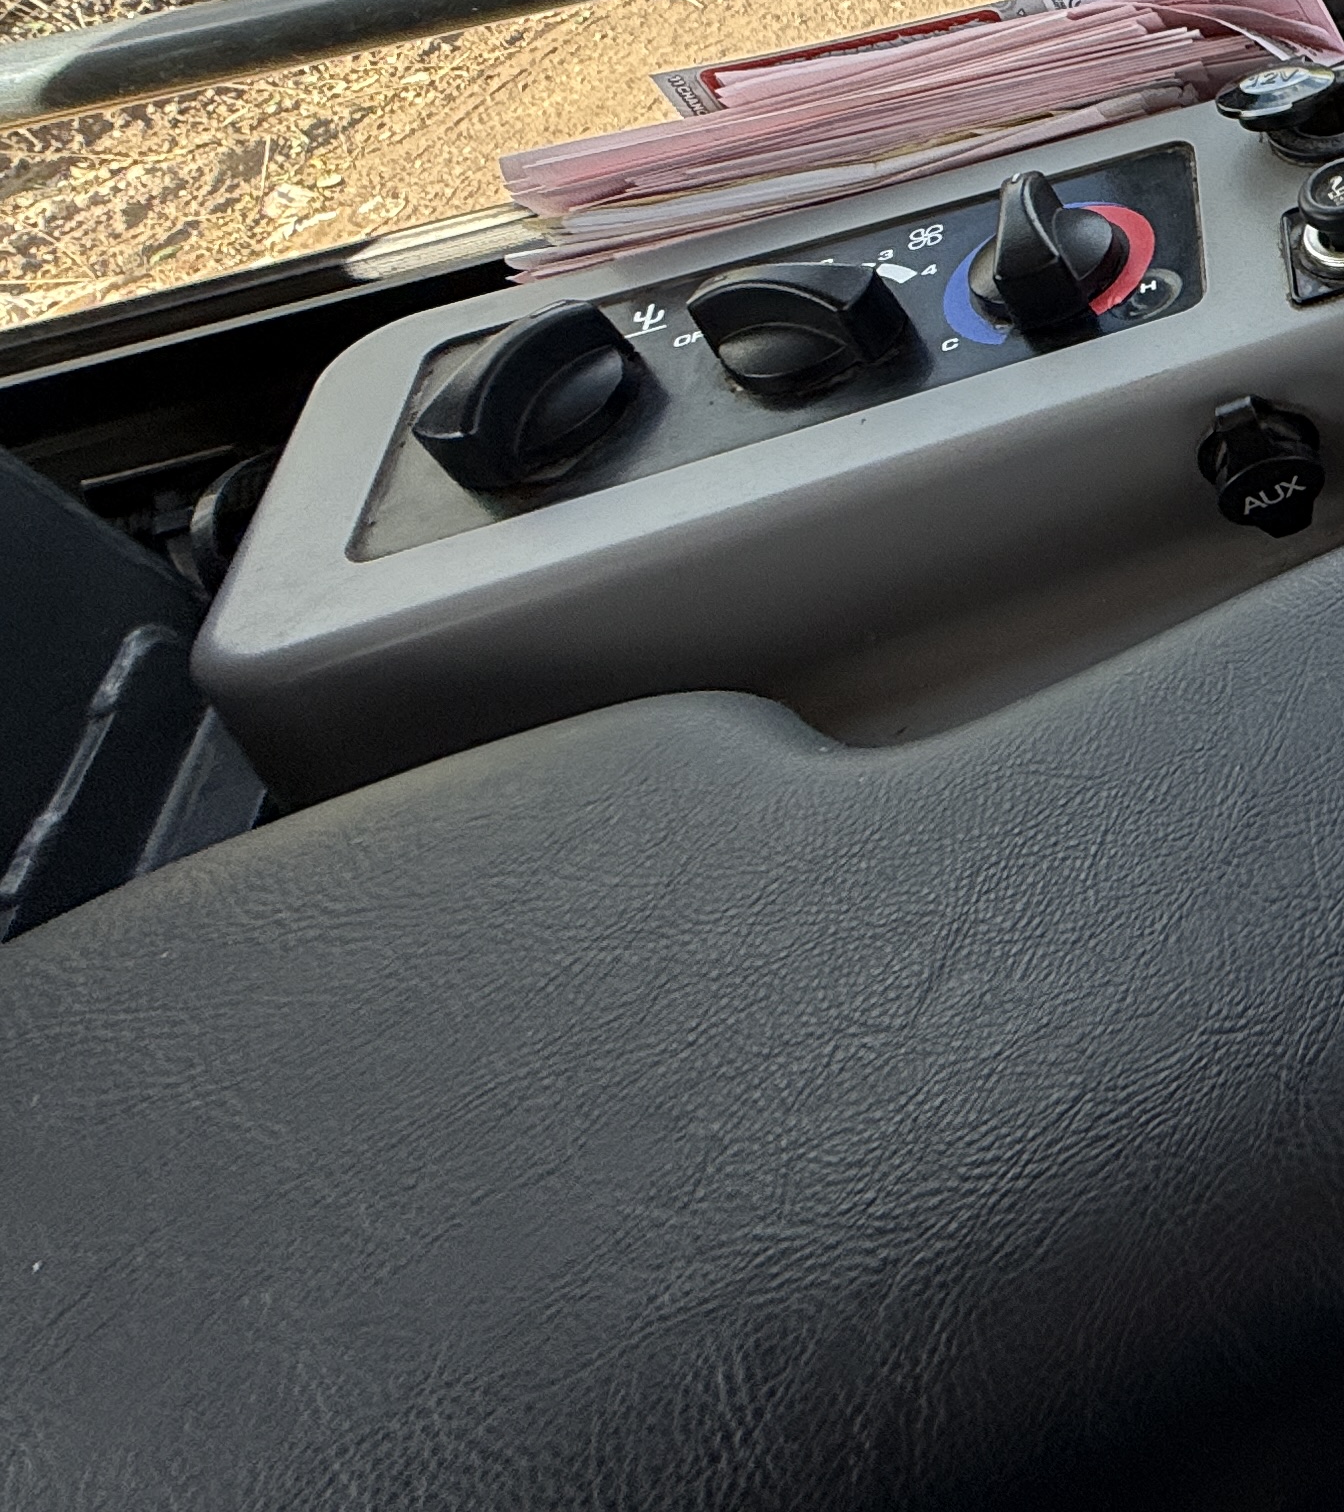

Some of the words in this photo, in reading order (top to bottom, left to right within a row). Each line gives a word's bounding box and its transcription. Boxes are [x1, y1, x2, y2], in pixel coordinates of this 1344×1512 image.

[1246, 69, 1300, 88] 12V
[877, 249, 894, 261] 3
[921, 264, 938, 276] 4
[1140, 280, 1157, 294] H
[673, 330, 705, 348] OF
[941, 338, 959, 352] C
[1243, 474, 1307, 516] AUX
